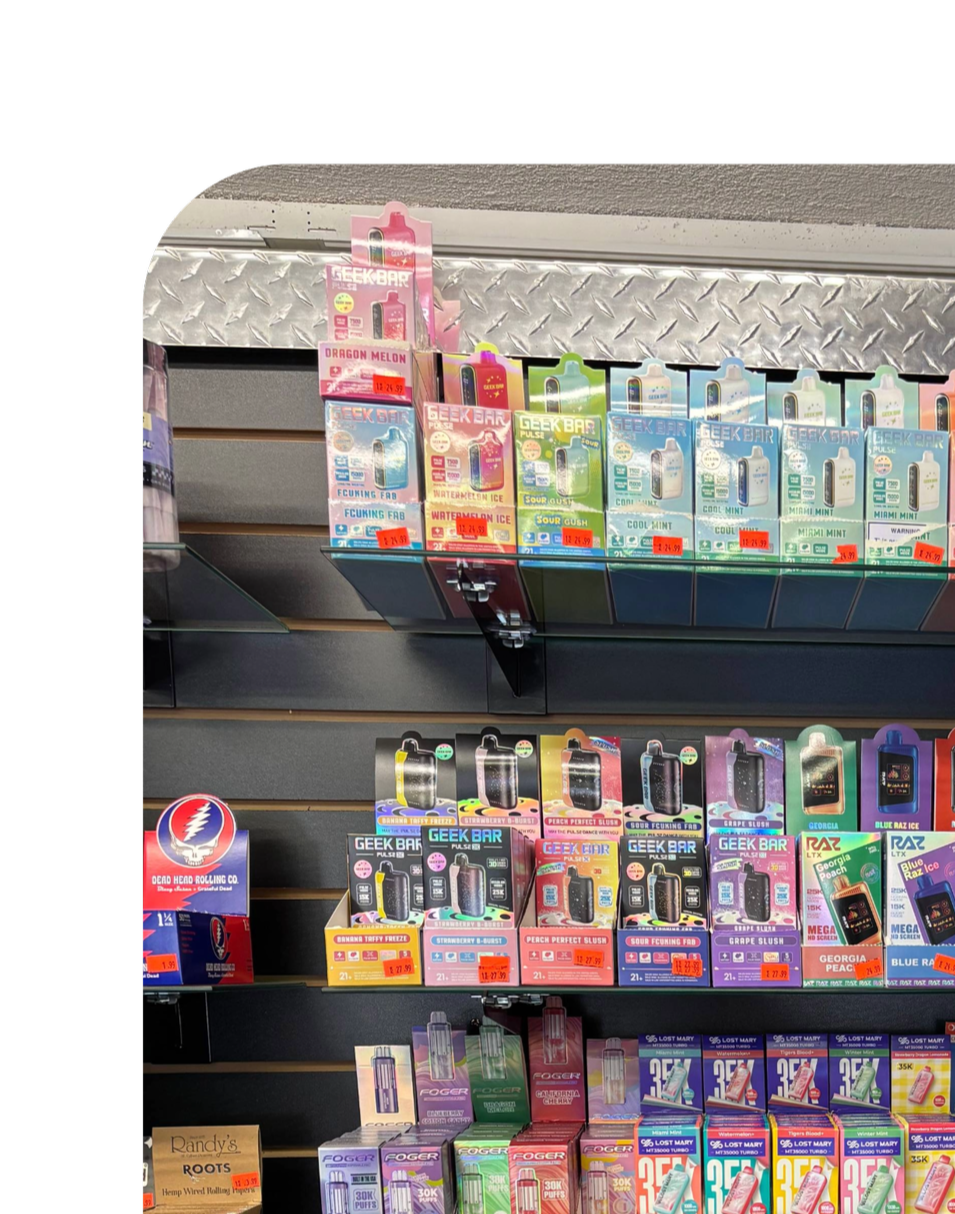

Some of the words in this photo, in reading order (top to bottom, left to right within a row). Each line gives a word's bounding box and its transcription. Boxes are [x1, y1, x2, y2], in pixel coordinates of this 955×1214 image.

[325, 348, 367, 360] DRAGON
[370, 352, 406, 363] MELON
[519, 417, 561, 433] GEEK
[564, 419, 595, 436] BAR
[429, 828, 469, 843] GEEK
[472, 828, 502, 843] BAR
[891, 836, 925, 850] RAZ
[816, 854, 851, 874] Georgia
[900, 858, 924, 871] Blue
[819, 865, 847, 881] Peach
[904, 866, 924, 881] Raz
[924, 861, 939, 874] Ice
[152, 875, 171, 884] DEAD
[174, 876, 192, 884] HEAD
[196, 876, 226, 884] ROLLING
[228, 876, 239, 884] CO.
[891, 925, 919, 934] MEGA
[337, 935, 362, 943] BANANA
[364, 935, 382, 943] TAFFY
[729, 937, 753, 945] GRAPE
[756, 937, 783, 945] SLUSH
[171, 1134, 241, 1157] Randy's
[183, 1163, 231, 1176] ROOTS
[356, 1191, 373, 1201] 30K
[355, 1201, 377, 1210] PUFFS
